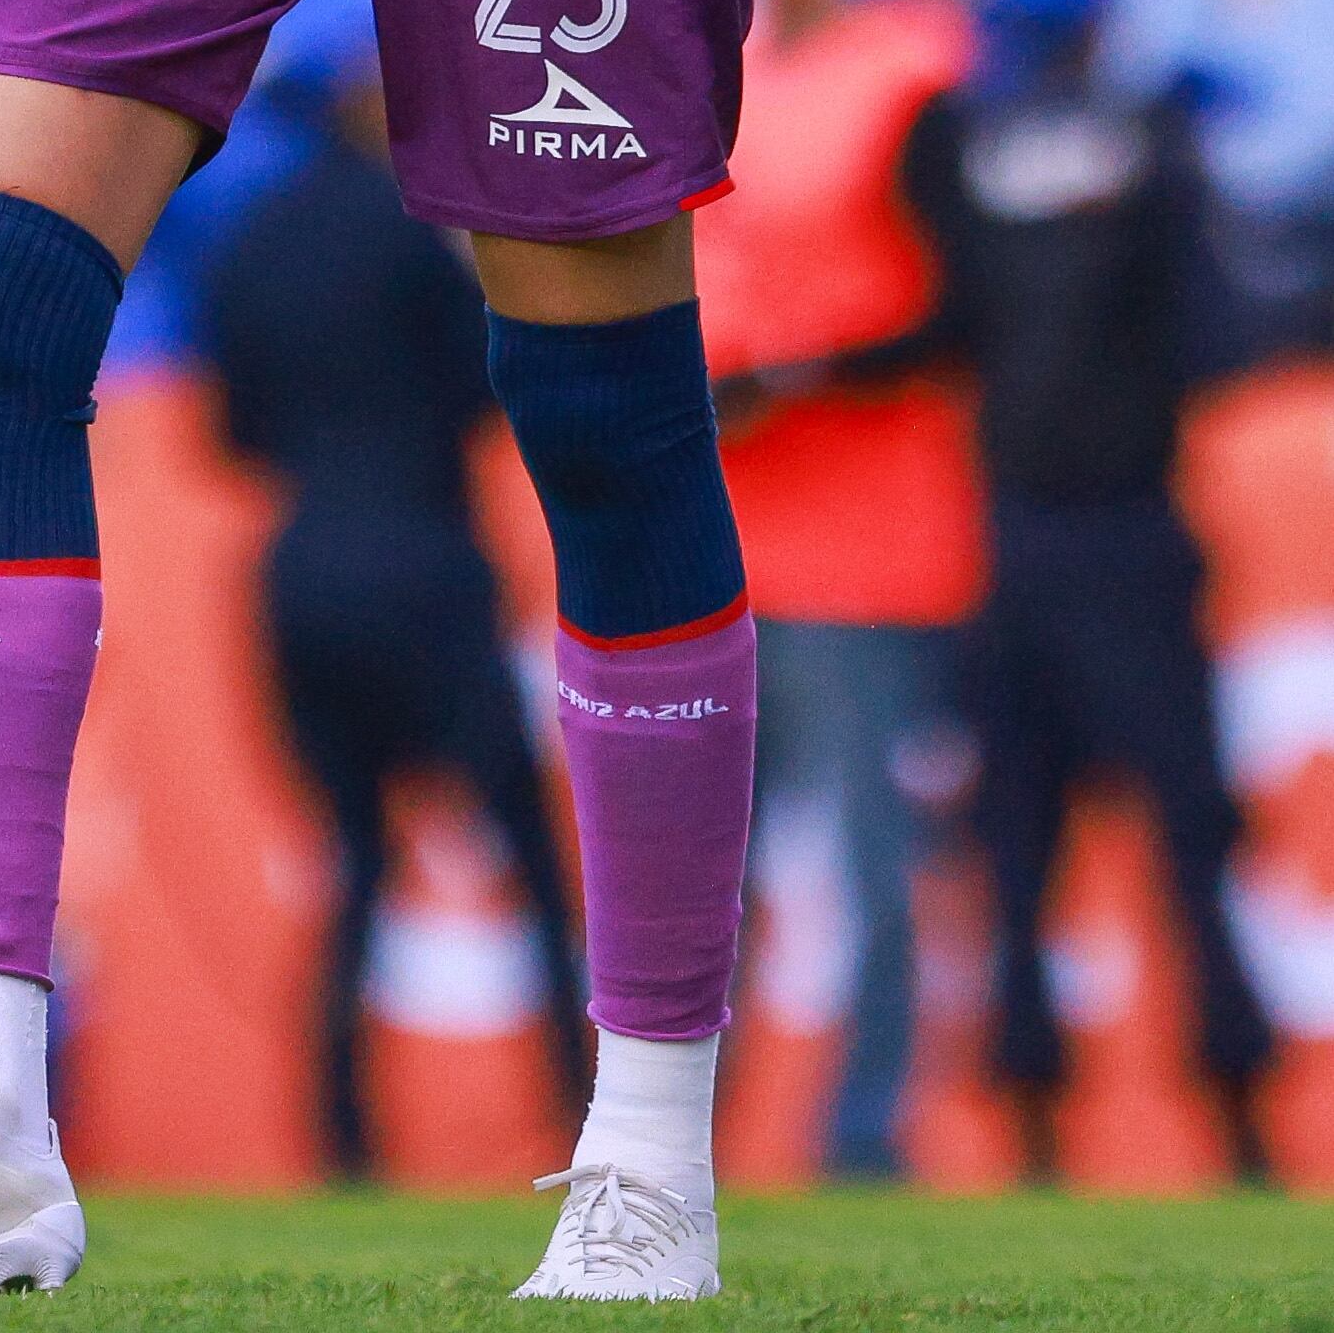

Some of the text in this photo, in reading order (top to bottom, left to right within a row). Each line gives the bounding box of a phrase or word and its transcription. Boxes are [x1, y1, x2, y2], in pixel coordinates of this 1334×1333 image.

[488, 120, 647, 160] PIRMA
[558, 680, 730, 721] CRUZ AZUL
